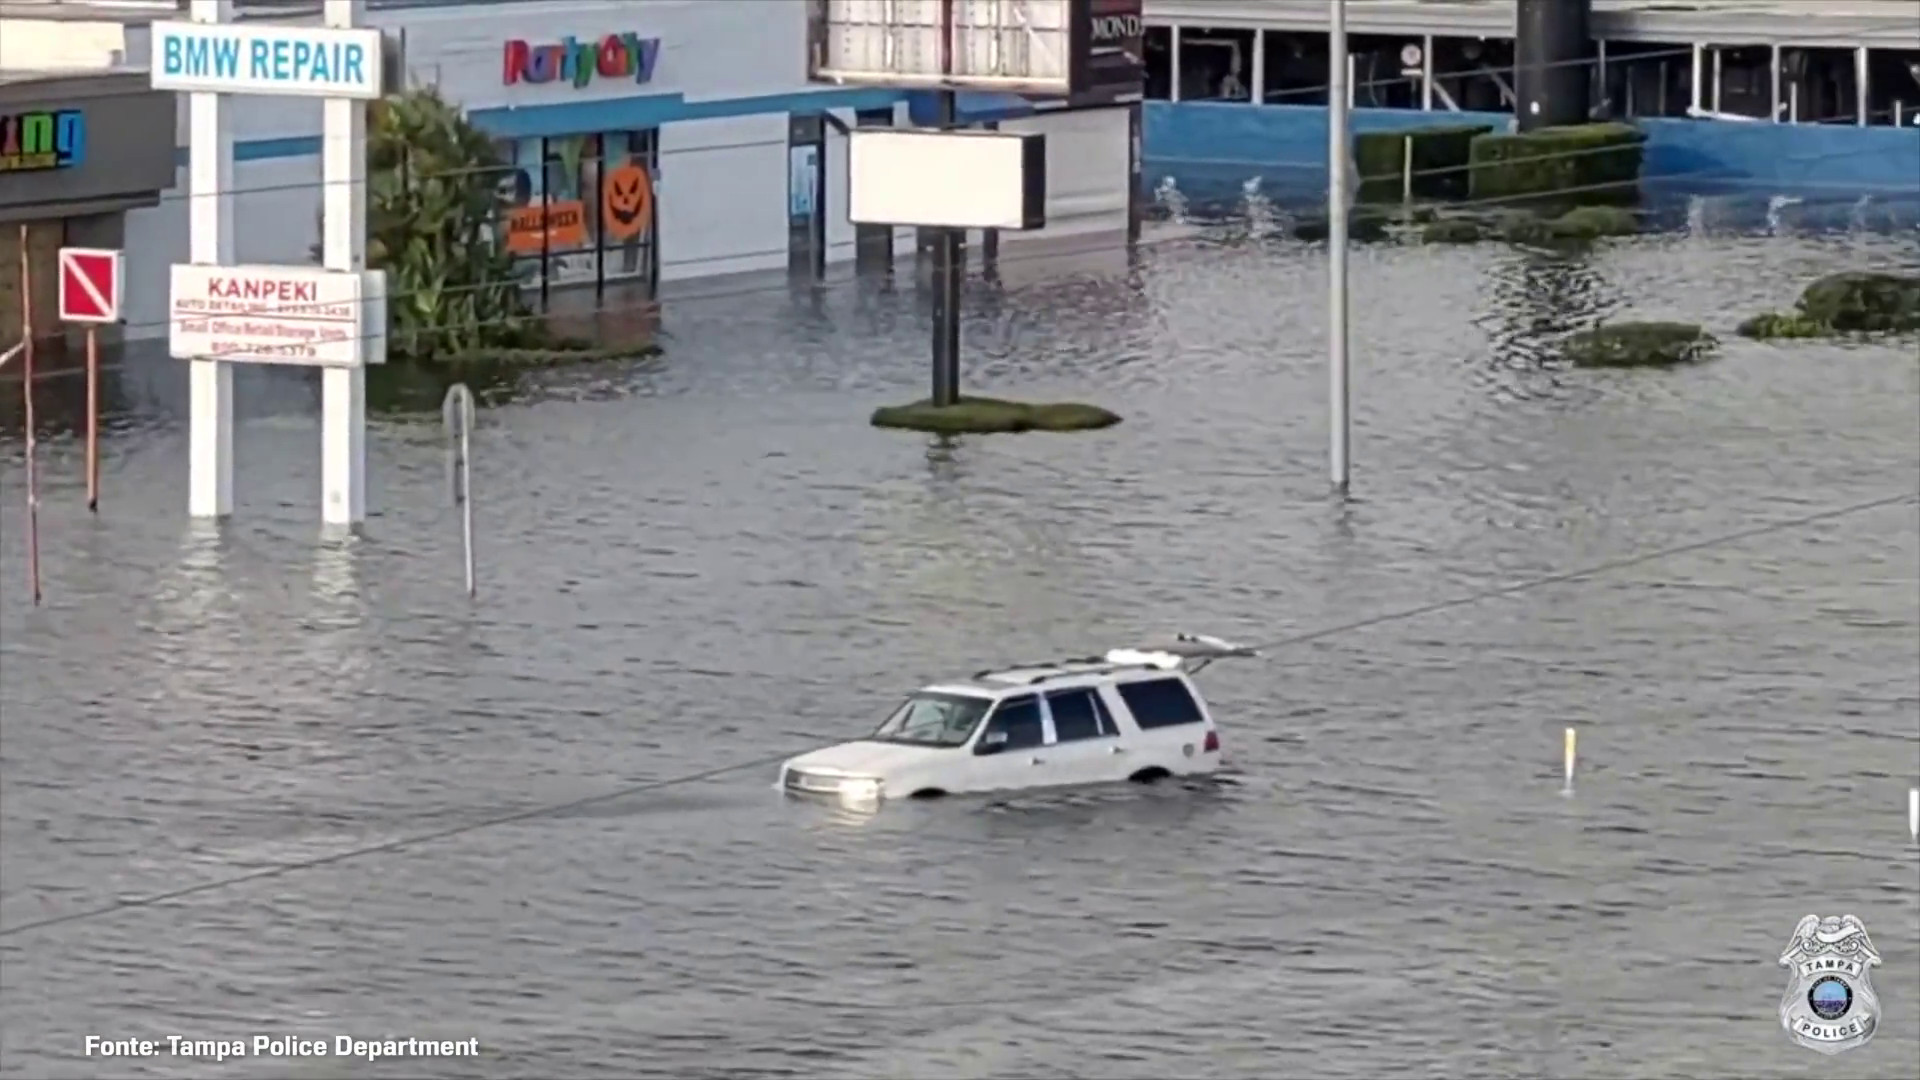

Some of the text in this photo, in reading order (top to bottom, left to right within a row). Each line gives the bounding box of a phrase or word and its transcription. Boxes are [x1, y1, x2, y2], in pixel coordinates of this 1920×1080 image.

[164, 36, 364, 84] BMW REPAIR
[207, 278, 317, 301] KANPEKI
